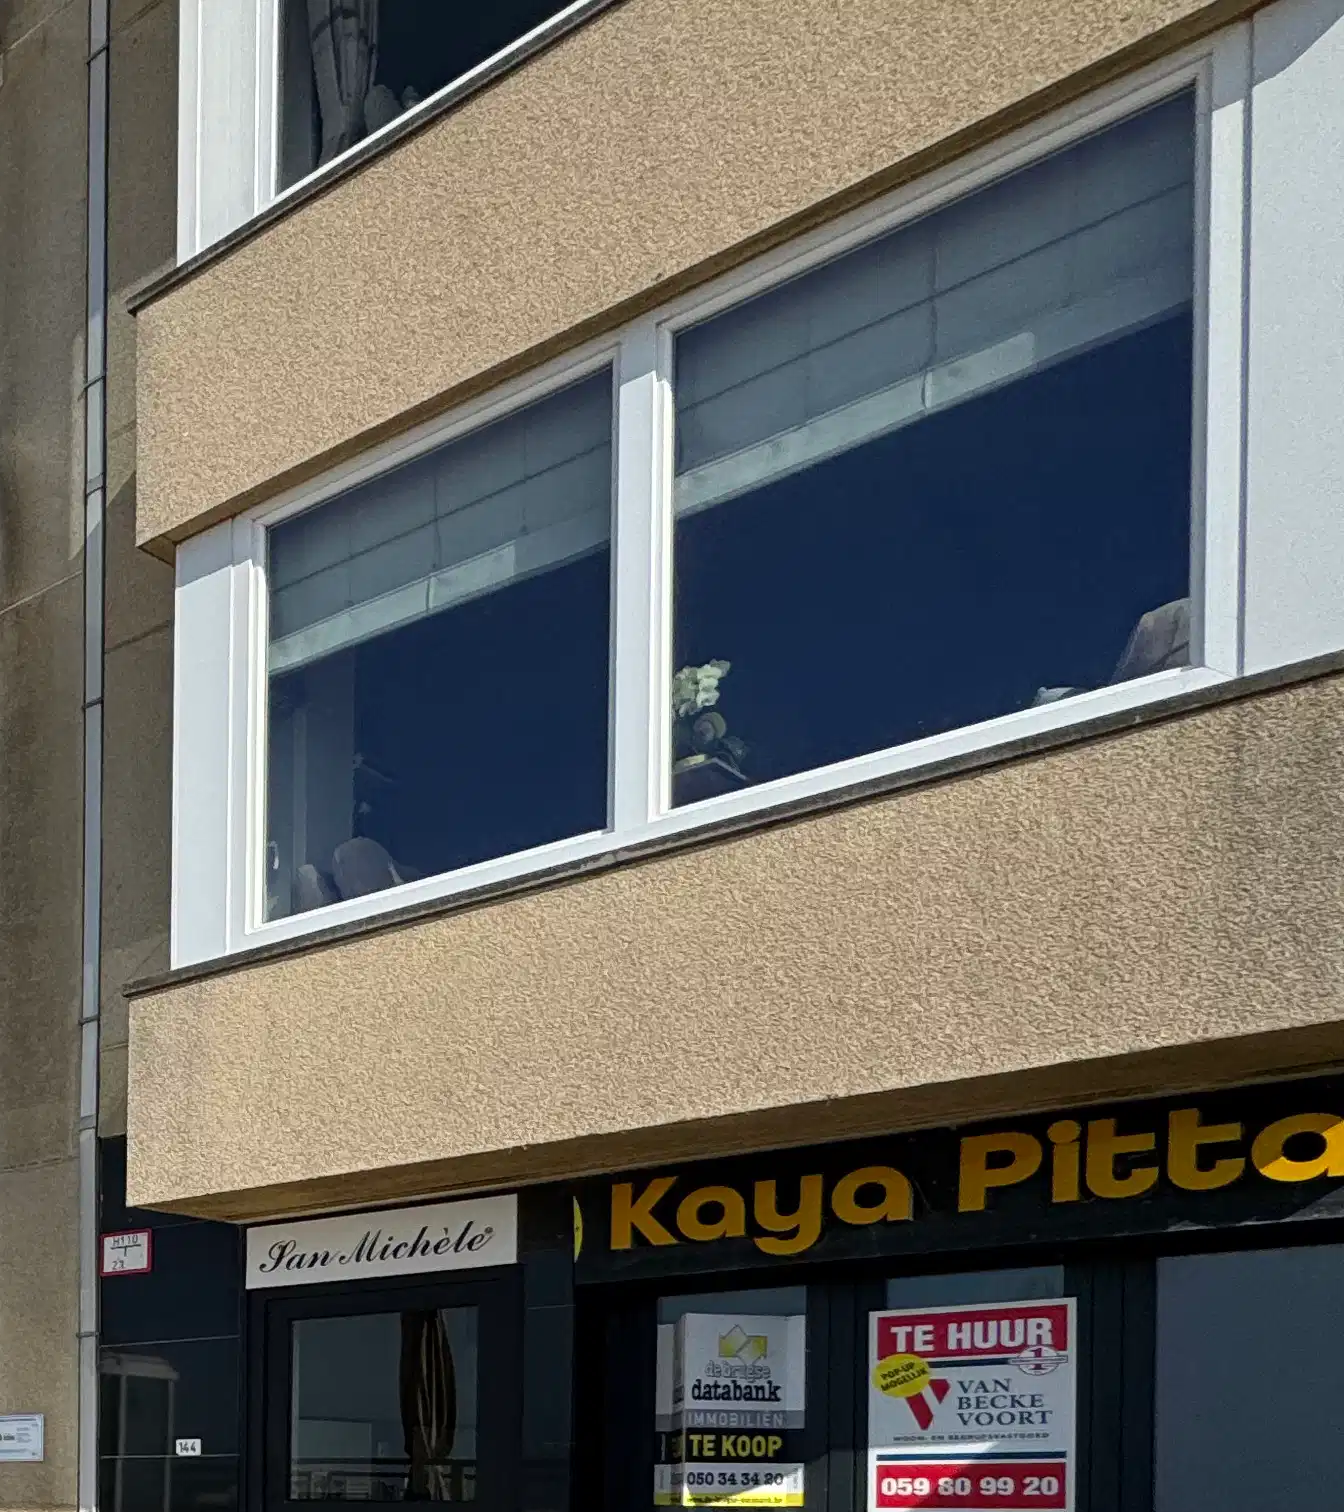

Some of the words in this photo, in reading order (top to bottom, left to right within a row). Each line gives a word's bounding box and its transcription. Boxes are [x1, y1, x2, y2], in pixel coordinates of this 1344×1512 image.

[610, 1166, 912, 1255] Kaya
[958, 1108, 1344, 1211] Pitta
[259, 1239, 340, 1273] San
[339, 1220, 495, 1265] Michèle
[890, 1324, 935, 1352] TE
[947, 1317, 1053, 1350] HUUR
[880, 1362, 916, 1381] POP-UP
[691, 1379, 783, 1402] databank
[958, 1378, 1011, 1394] VAN
[957, 1394, 1045, 1410] BECKE
[957, 1410, 1054, 1426] VOORT
[689, 1434, 717, 1457] TE
[721, 1434, 783, 1458] KOOP
[686, 1472, 714, 1486] 050
[718, 1472, 738, 1486] 34
[741, 1472, 761, 1486] 34
[763, 1472, 784, 1486] 20
[881, 1477, 930, 1496] 059
[937, 1477, 971, 1496] 80
[979, 1476, 1015, 1496] 99
[1023, 1476, 1059, 1495] 20
